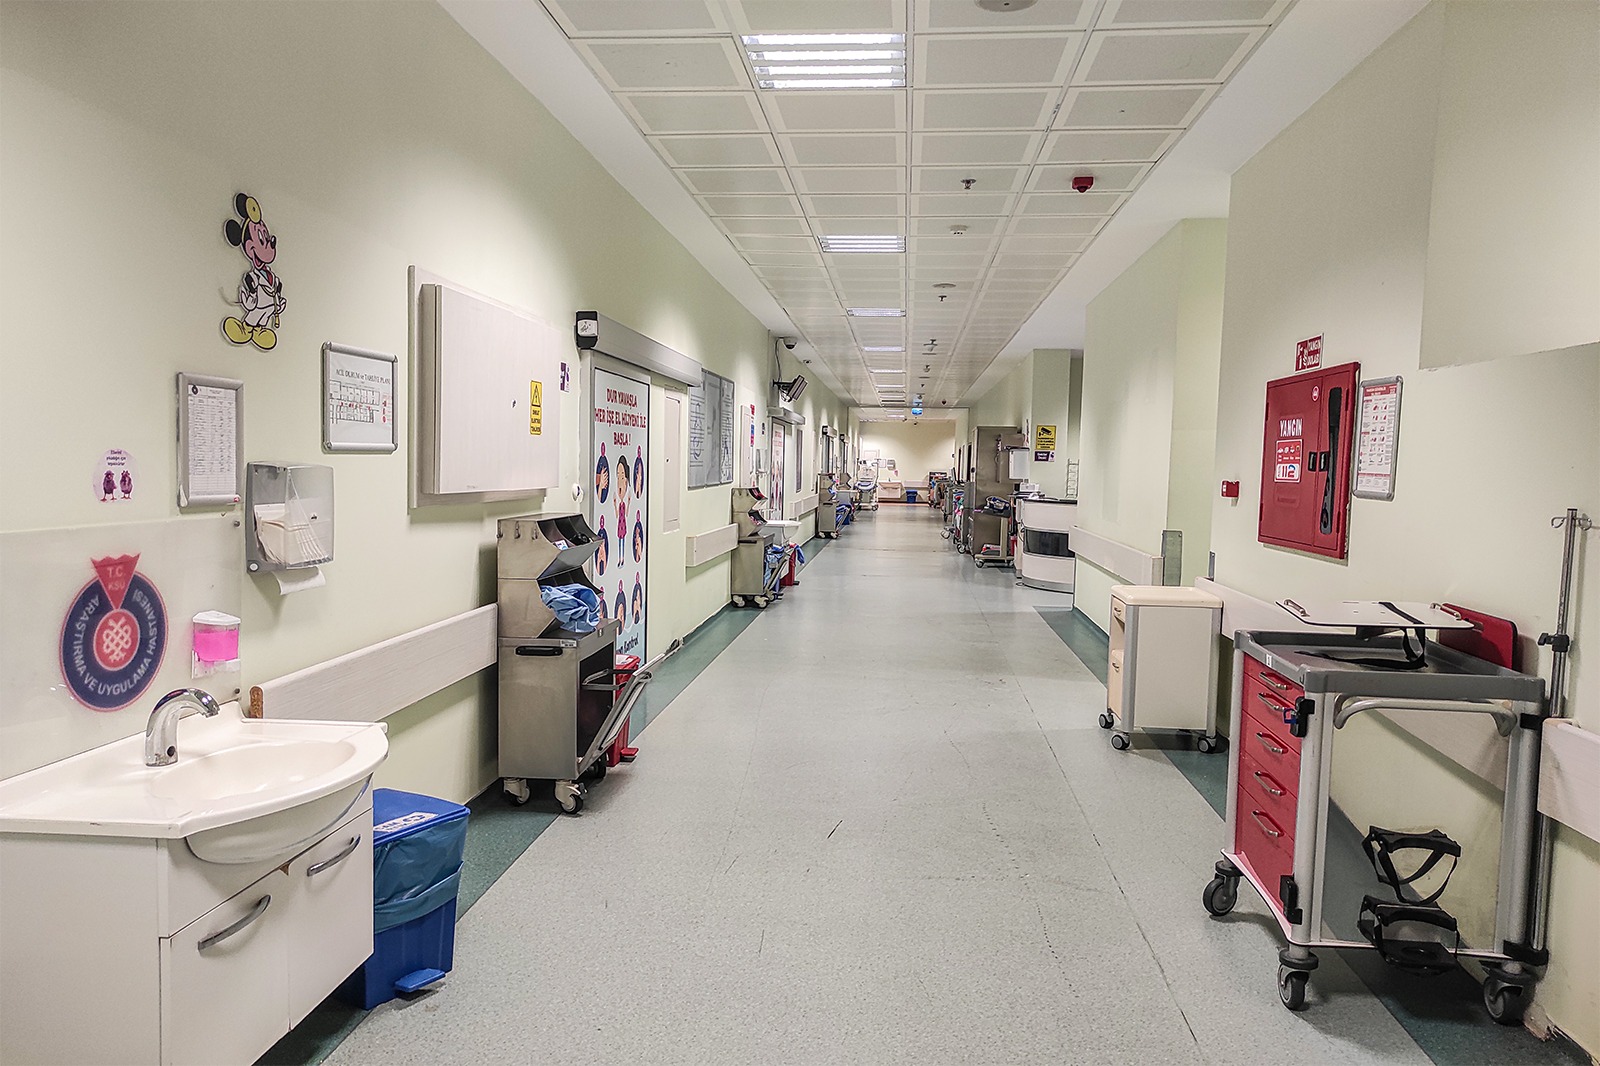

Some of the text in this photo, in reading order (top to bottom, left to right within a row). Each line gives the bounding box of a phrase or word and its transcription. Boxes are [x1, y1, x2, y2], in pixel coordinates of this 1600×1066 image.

[606, 388, 638, 410] DUR YAVAŞLA
[594, 408, 606, 422] HER
[616, 411, 621, 425] EL
[1280, 418, 1303, 437] YANGIN
[614, 432, 628, 448] BAŞLA
[1282, 464, 1296, 478] 112
[72, 588, 158, 696] ARAŞTIRMA VE UYGULAMA HASTANESİ
